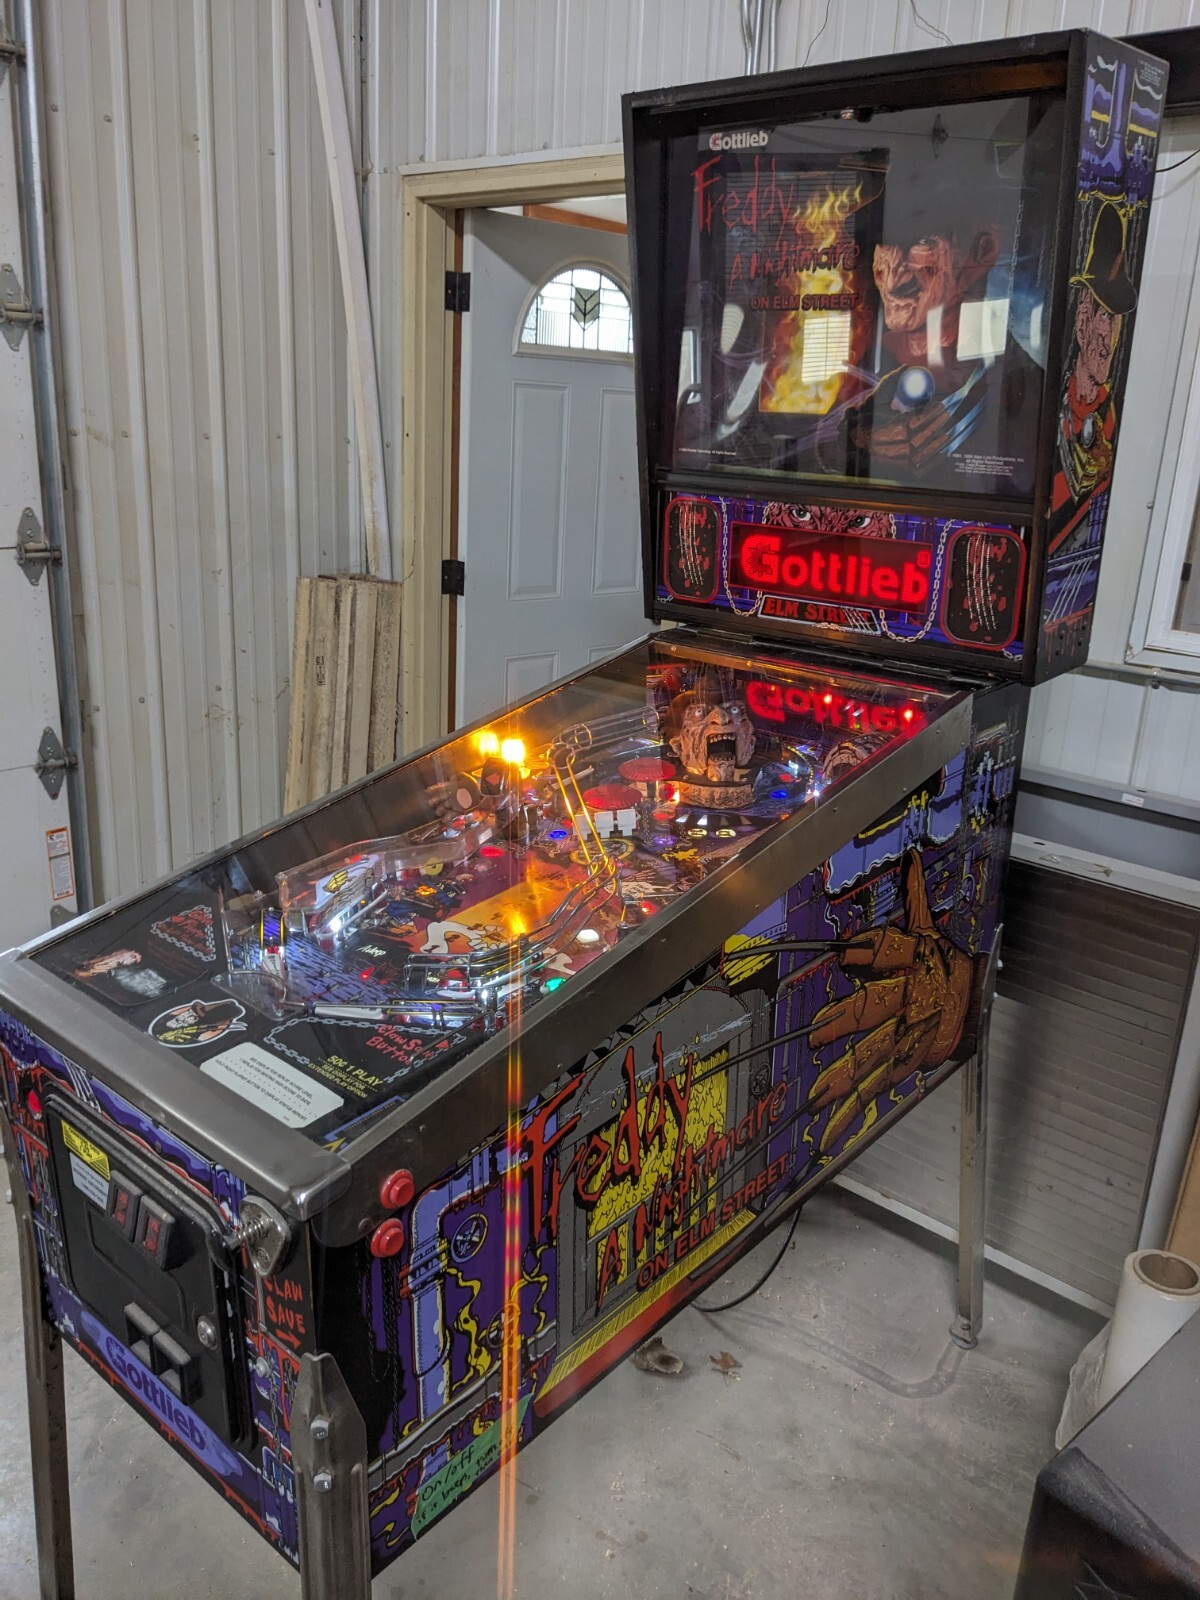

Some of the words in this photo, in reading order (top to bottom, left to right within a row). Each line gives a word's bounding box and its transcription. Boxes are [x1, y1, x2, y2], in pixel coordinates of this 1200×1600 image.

[709, 131, 769, 151] Gottlieb
[690, 154, 794, 247] Freddy
[751, 295, 770, 311] ON
[773, 295, 799, 311] ELM
[801, 294, 858, 311] STREET
[741, 534, 929, 604] Gottlieb
[764, 597, 799, 618] ELM
[308, 1063, 335, 1080] EXTENDED
[333, 1077, 349, 1088] PLAY
[352, 1068, 383, 1086] PLAY
[521, 1031, 694, 1243] Freddy
[598, 1227, 622, 1306] A
[634, 1080, 788, 1250] Nightmare
[638, 1254, 669, 1287] ON
[677, 1214, 716, 1258] ELM
[721, 1154, 788, 1220] STREET
[266, 1295, 306, 1334] SAVE
[105, 1336, 206, 1450] Gottlieb
